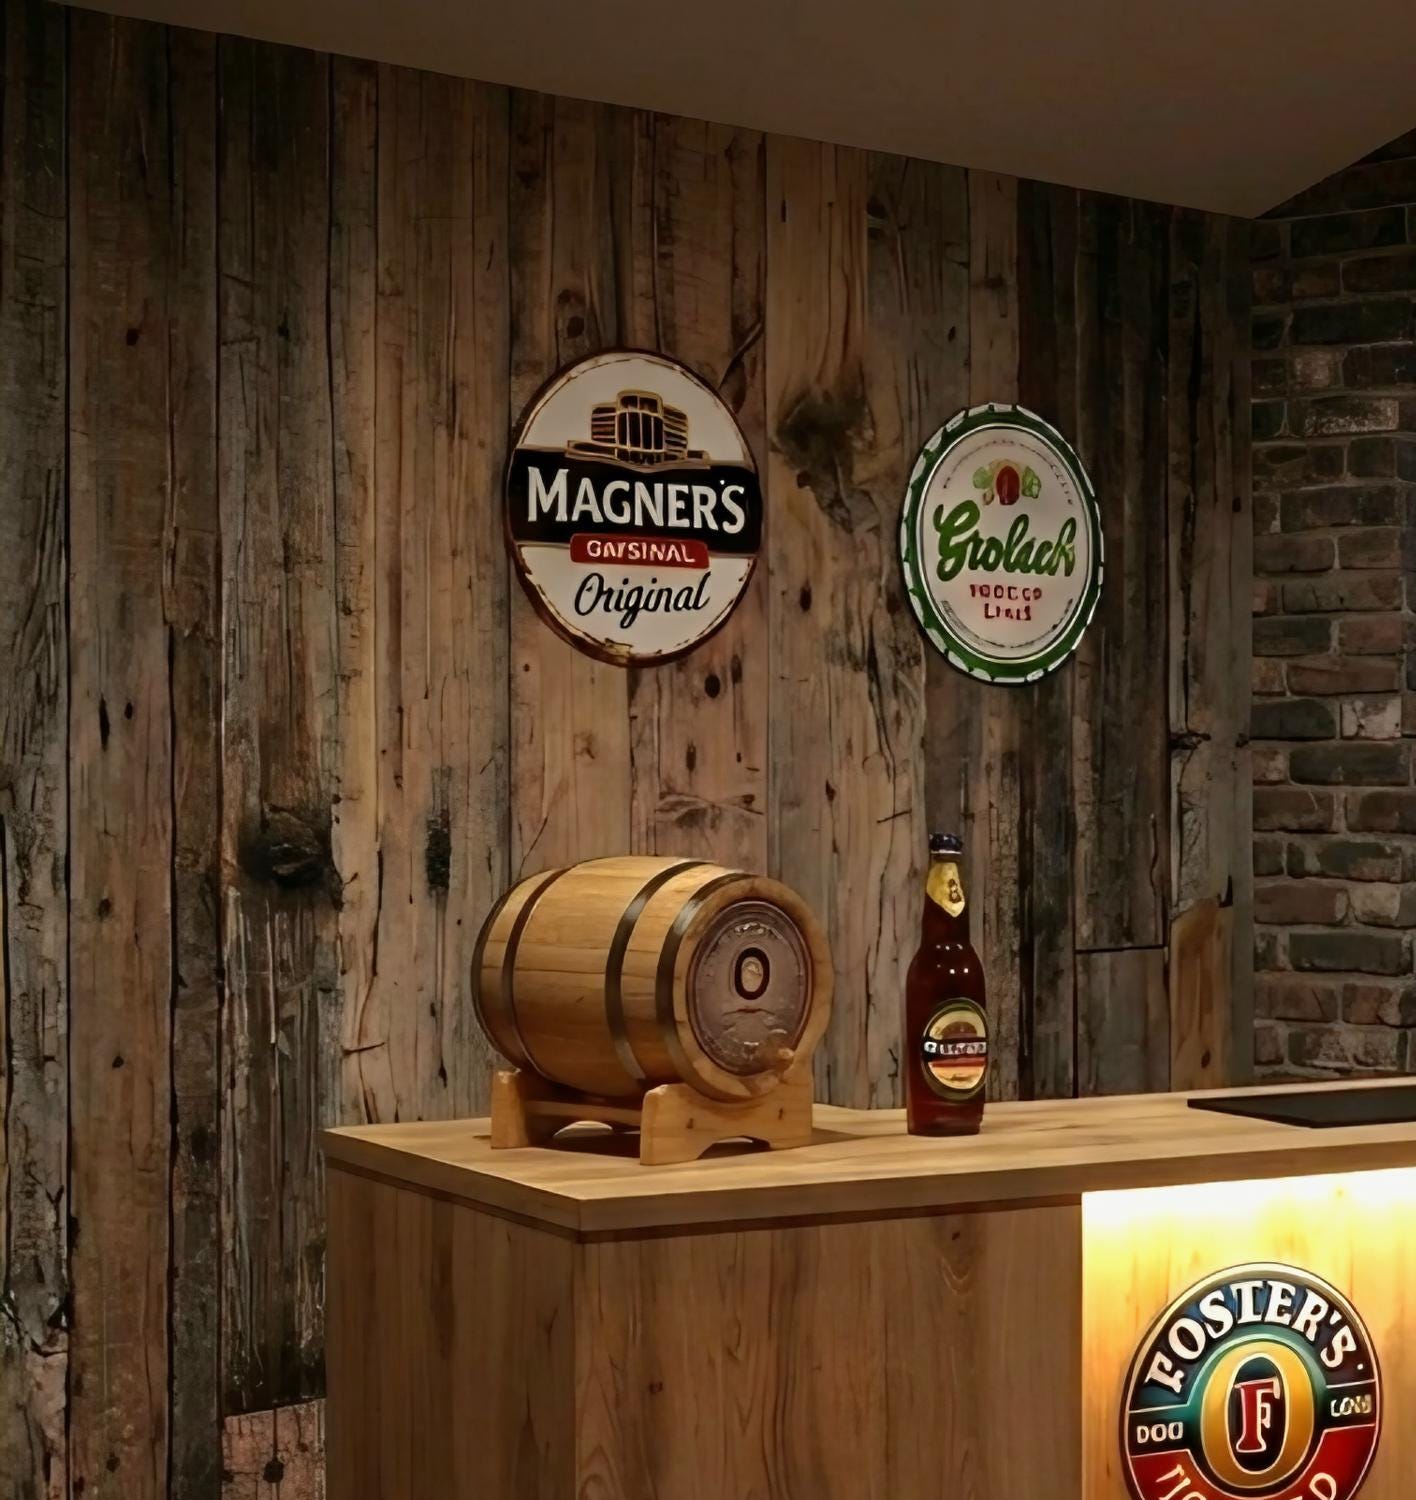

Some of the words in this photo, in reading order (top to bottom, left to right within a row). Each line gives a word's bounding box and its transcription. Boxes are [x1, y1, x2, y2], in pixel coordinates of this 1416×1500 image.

[527, 466, 746, 535] MAGNER'S
[574, 571, 712, 629] Original
[1144, 1280, 1358, 1394] FOSTER'S
